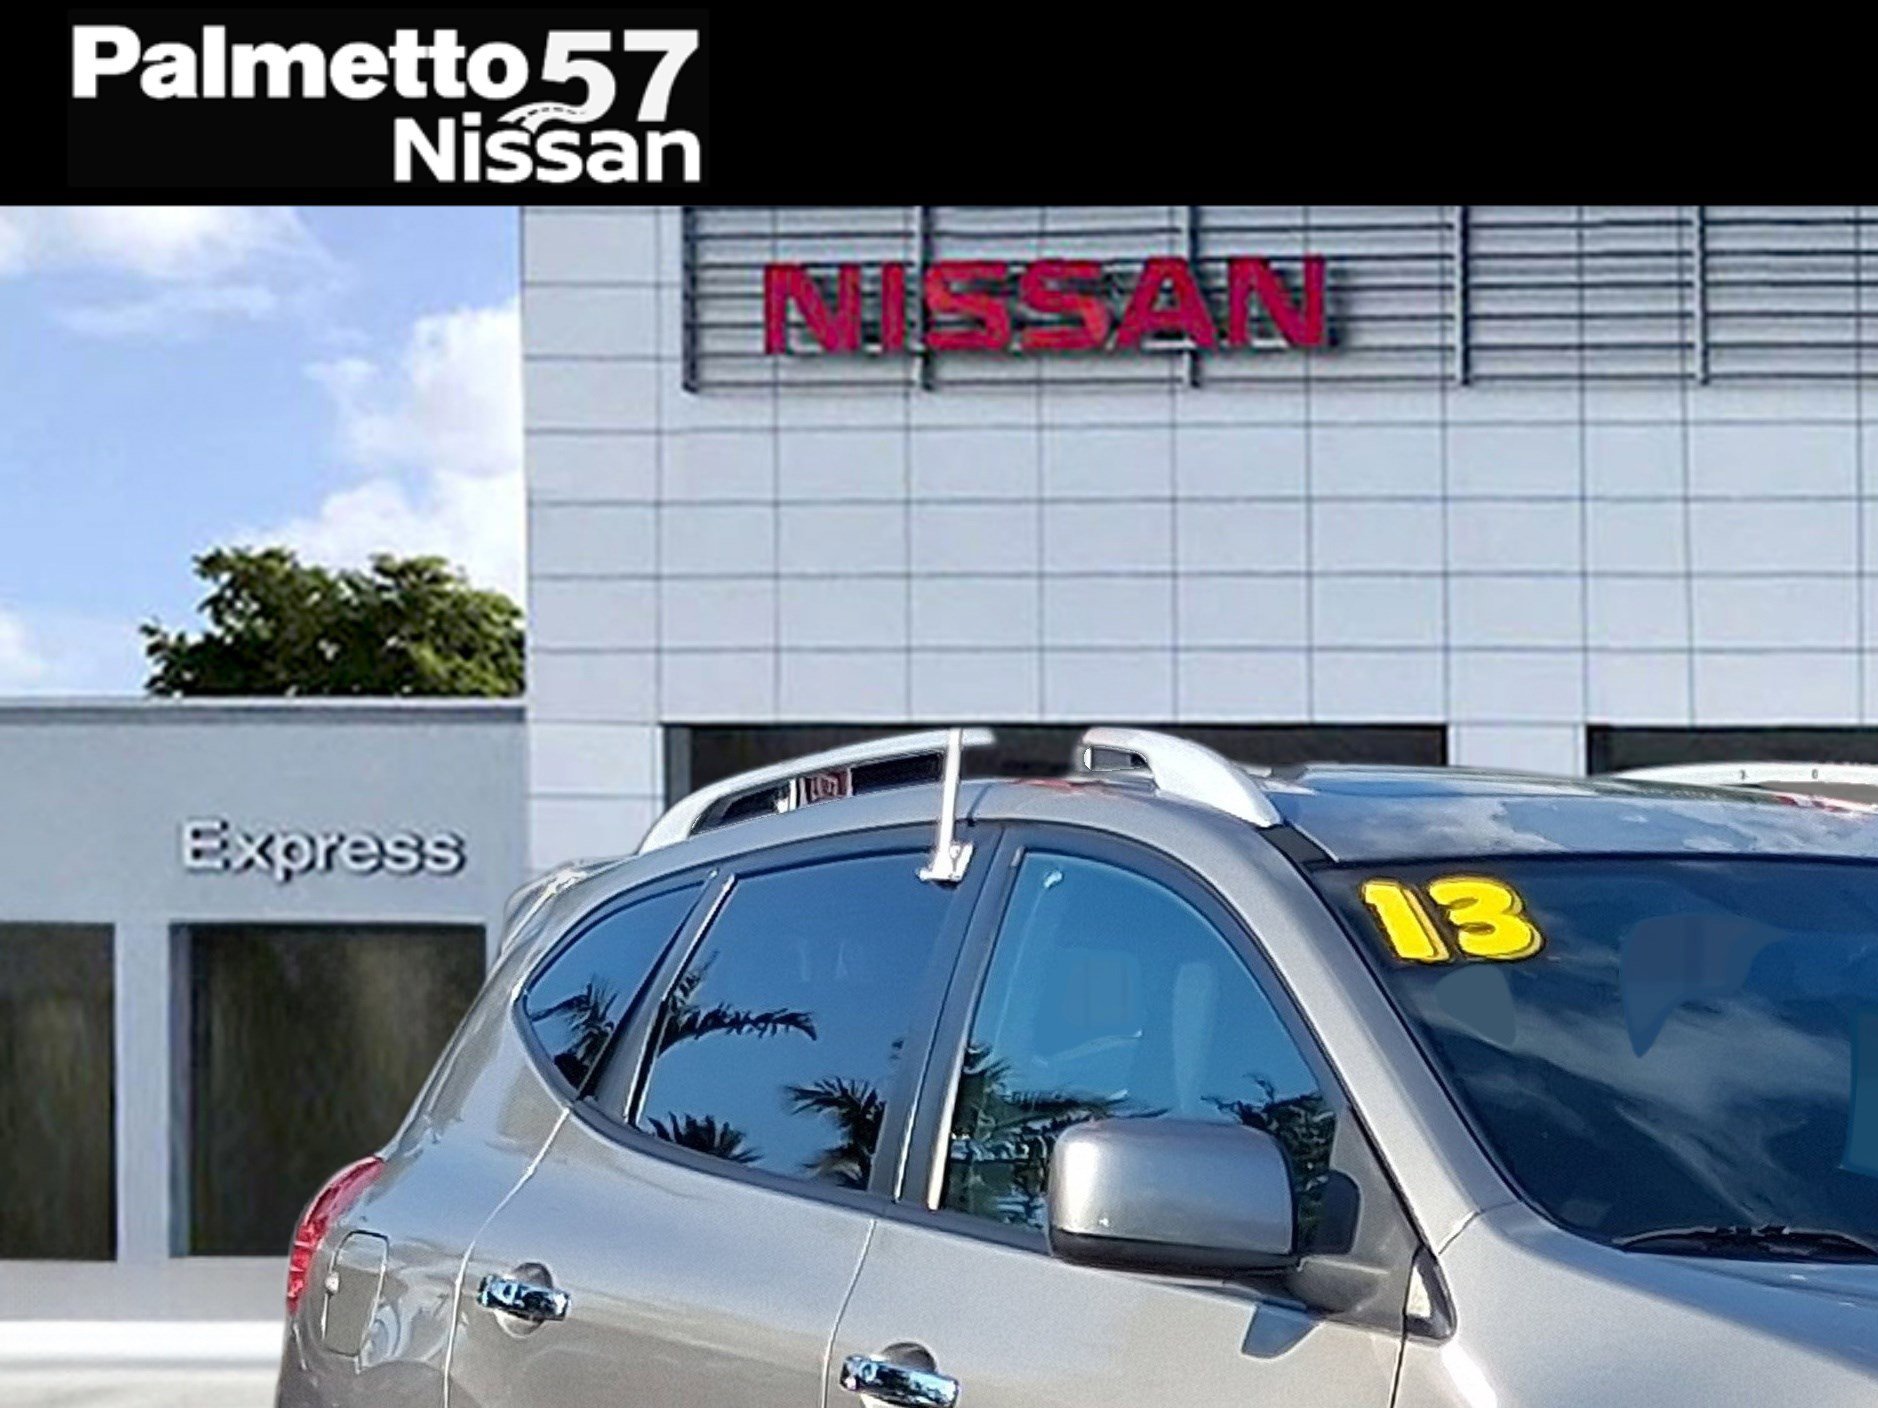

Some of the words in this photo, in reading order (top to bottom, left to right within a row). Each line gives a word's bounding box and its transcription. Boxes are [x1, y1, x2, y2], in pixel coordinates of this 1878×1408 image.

[764, 256, 1326, 356] NISSAN
[182, 819, 465, 883] Express
[1361, 876, 1543, 961] 13
